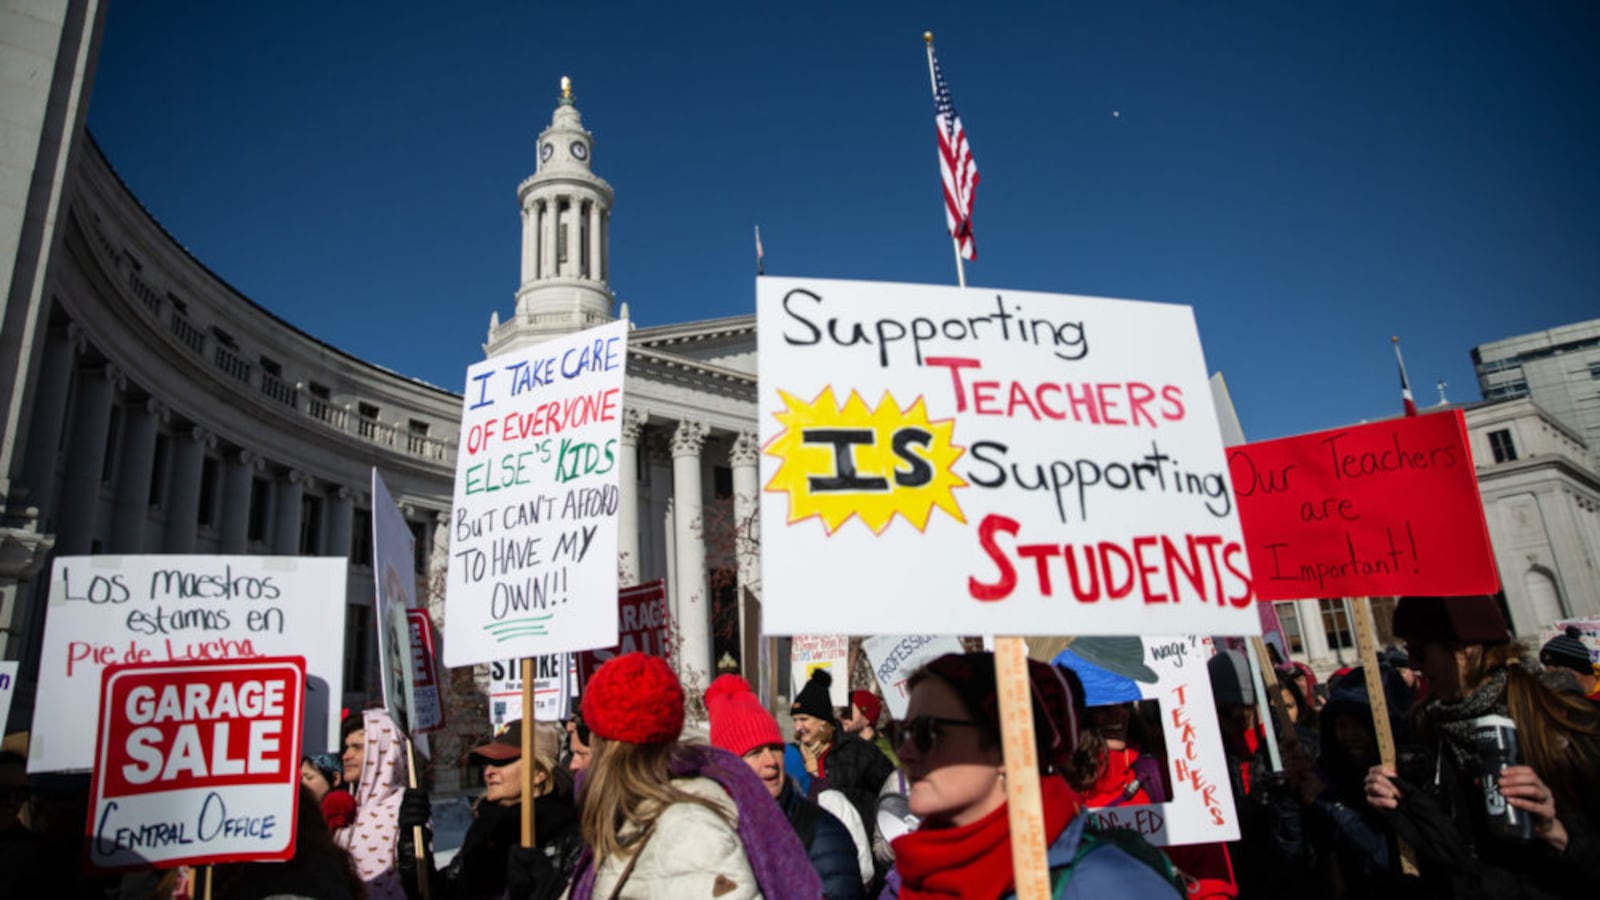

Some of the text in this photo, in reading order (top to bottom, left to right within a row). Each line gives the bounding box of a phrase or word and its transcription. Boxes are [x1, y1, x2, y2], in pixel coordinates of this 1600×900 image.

[782, 288, 1089, 367] Supporting
[470, 337, 620, 410] I TAKE CARE
[925, 356, 1186, 428] TEACHERS
[467, 388, 620, 455] OF EVERYONE
[465, 438, 617, 495] ELSE'S KIDS
[802, 427, 1233, 523] IS Supporting
[1228, 431, 1458, 497] Our Teachers
[503, 495, 557, 529] CAN'T
[561, 484, 619, 520] AFFORD
[1300, 498, 1361, 523] are
[63, 563, 281, 604] Los maestros
[456, 524, 598, 584] TO HAVE MY
[968, 513, 1255, 609] STUDENTS
[1264, 520, 1421, 590] Important!
[126, 606, 284, 635] estamos en
[491, 566, 568, 621] OWN!!
[125, 679, 285, 725] GARAGE
[121, 719, 281, 785] SALE
[1171, 684, 1226, 826] TEACHERS
[97, 791, 276, 857] CENTRAL OFFICE
